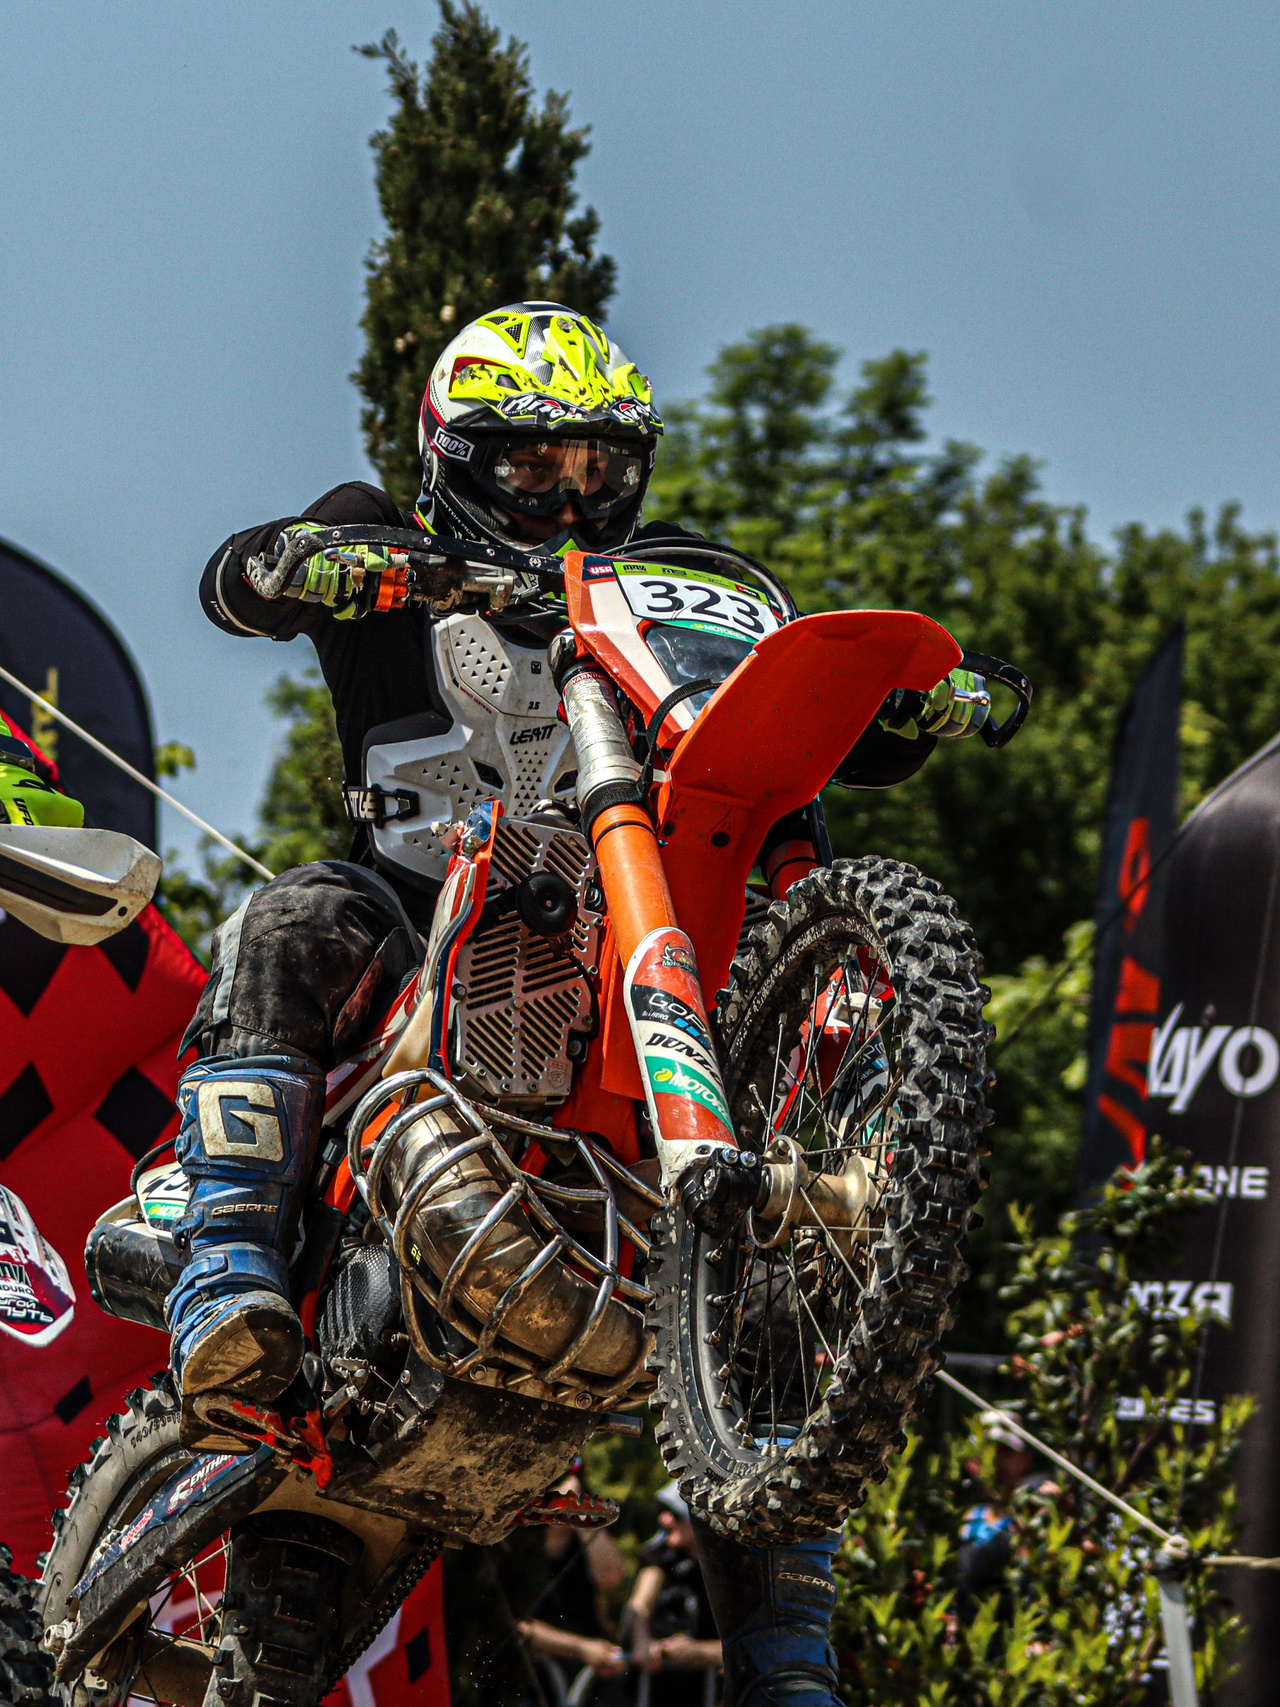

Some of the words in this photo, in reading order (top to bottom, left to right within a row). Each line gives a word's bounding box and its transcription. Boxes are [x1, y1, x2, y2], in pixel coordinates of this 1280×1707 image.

[437, 433, 469, 457] 100%
[639, 580, 766, 634] 323
[702, 624, 748, 642] MOTOREX
[509, 723, 559, 745] LEATT
